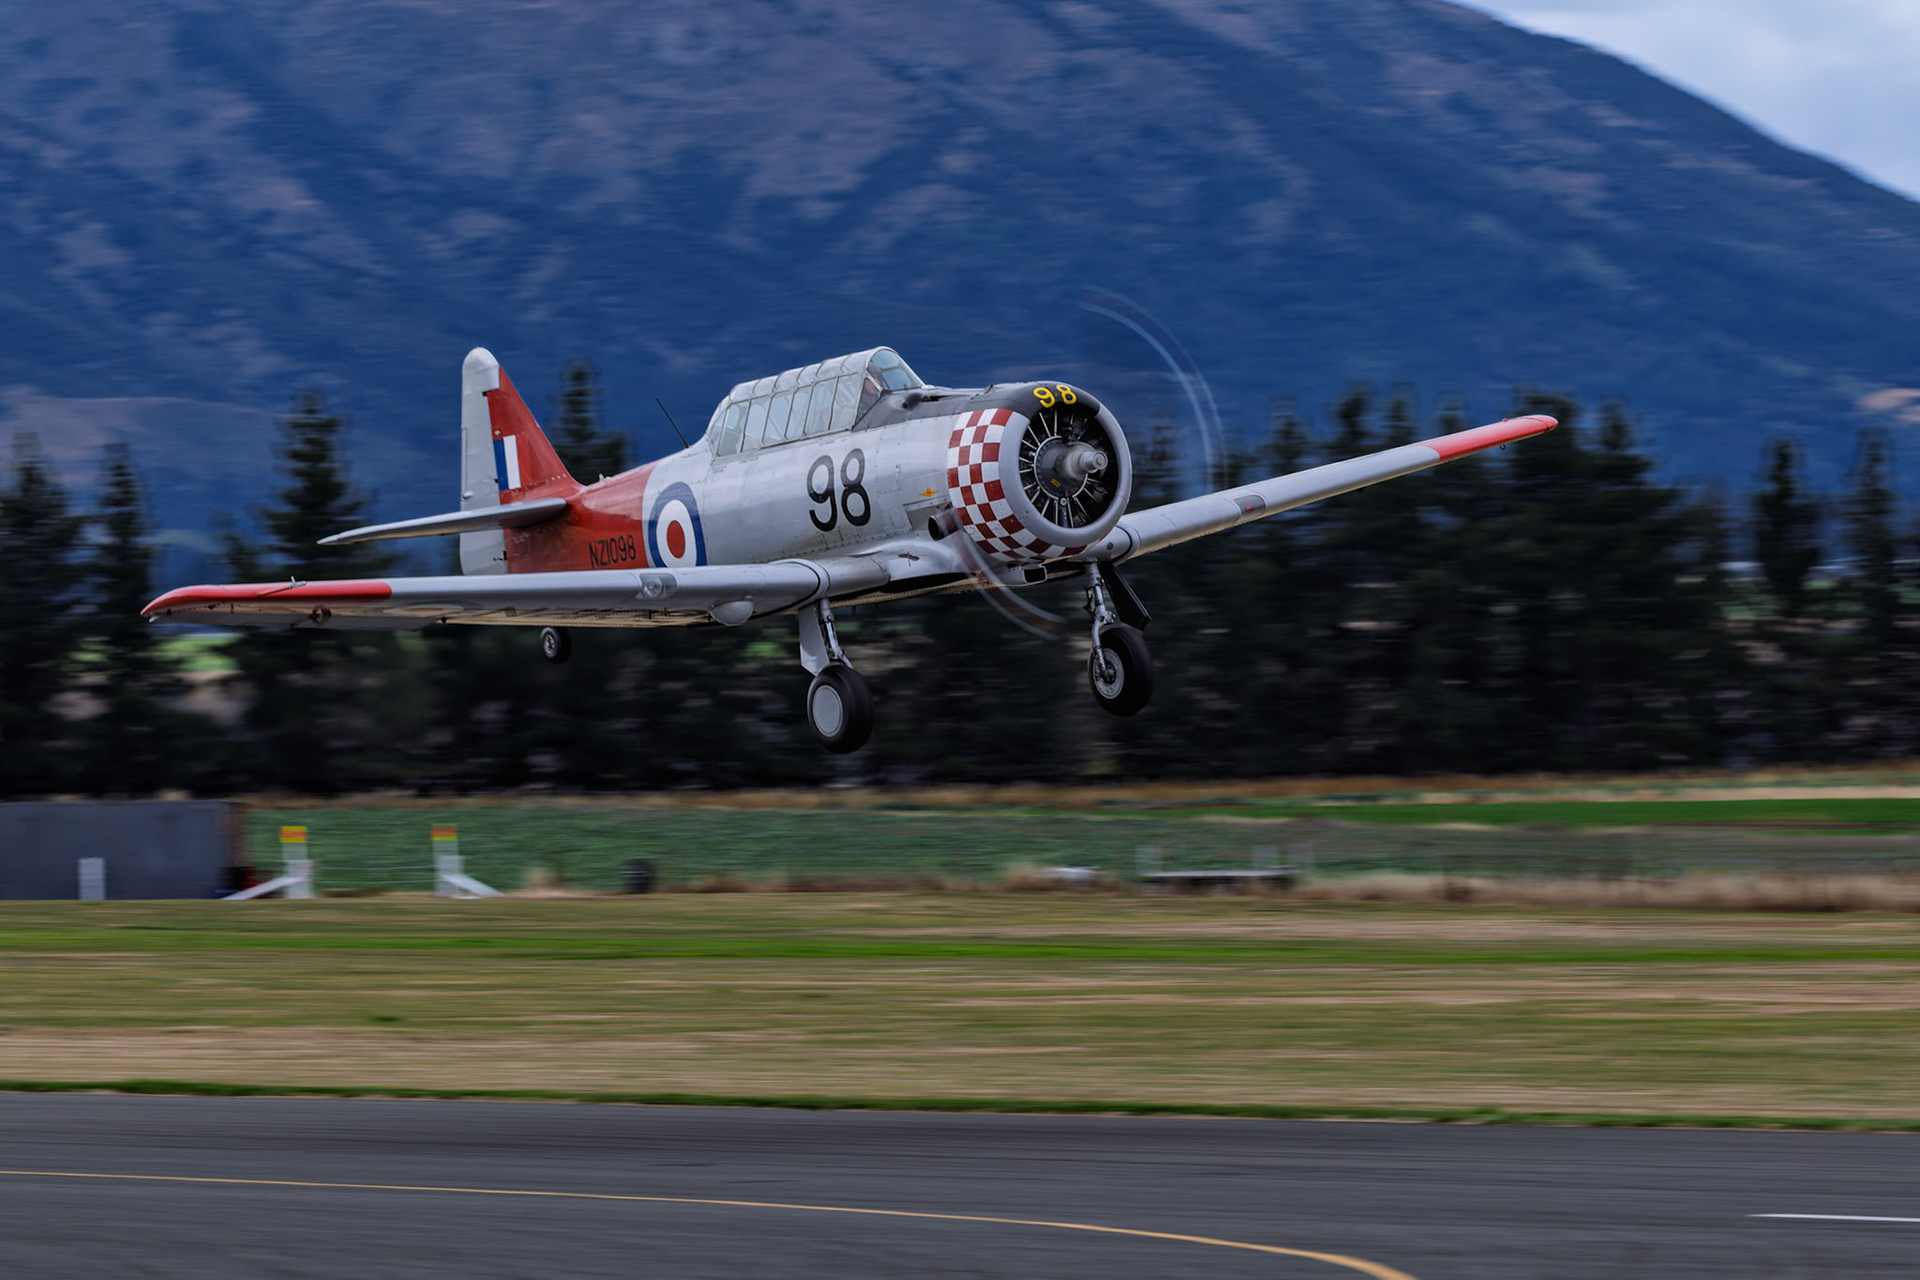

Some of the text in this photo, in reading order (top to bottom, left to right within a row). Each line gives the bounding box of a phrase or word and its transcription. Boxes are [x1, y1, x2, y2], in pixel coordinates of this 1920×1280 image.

[1033, 384, 1077, 408] 98
[807, 448, 871, 532] 98
[589, 534, 636, 568] NZ1098
